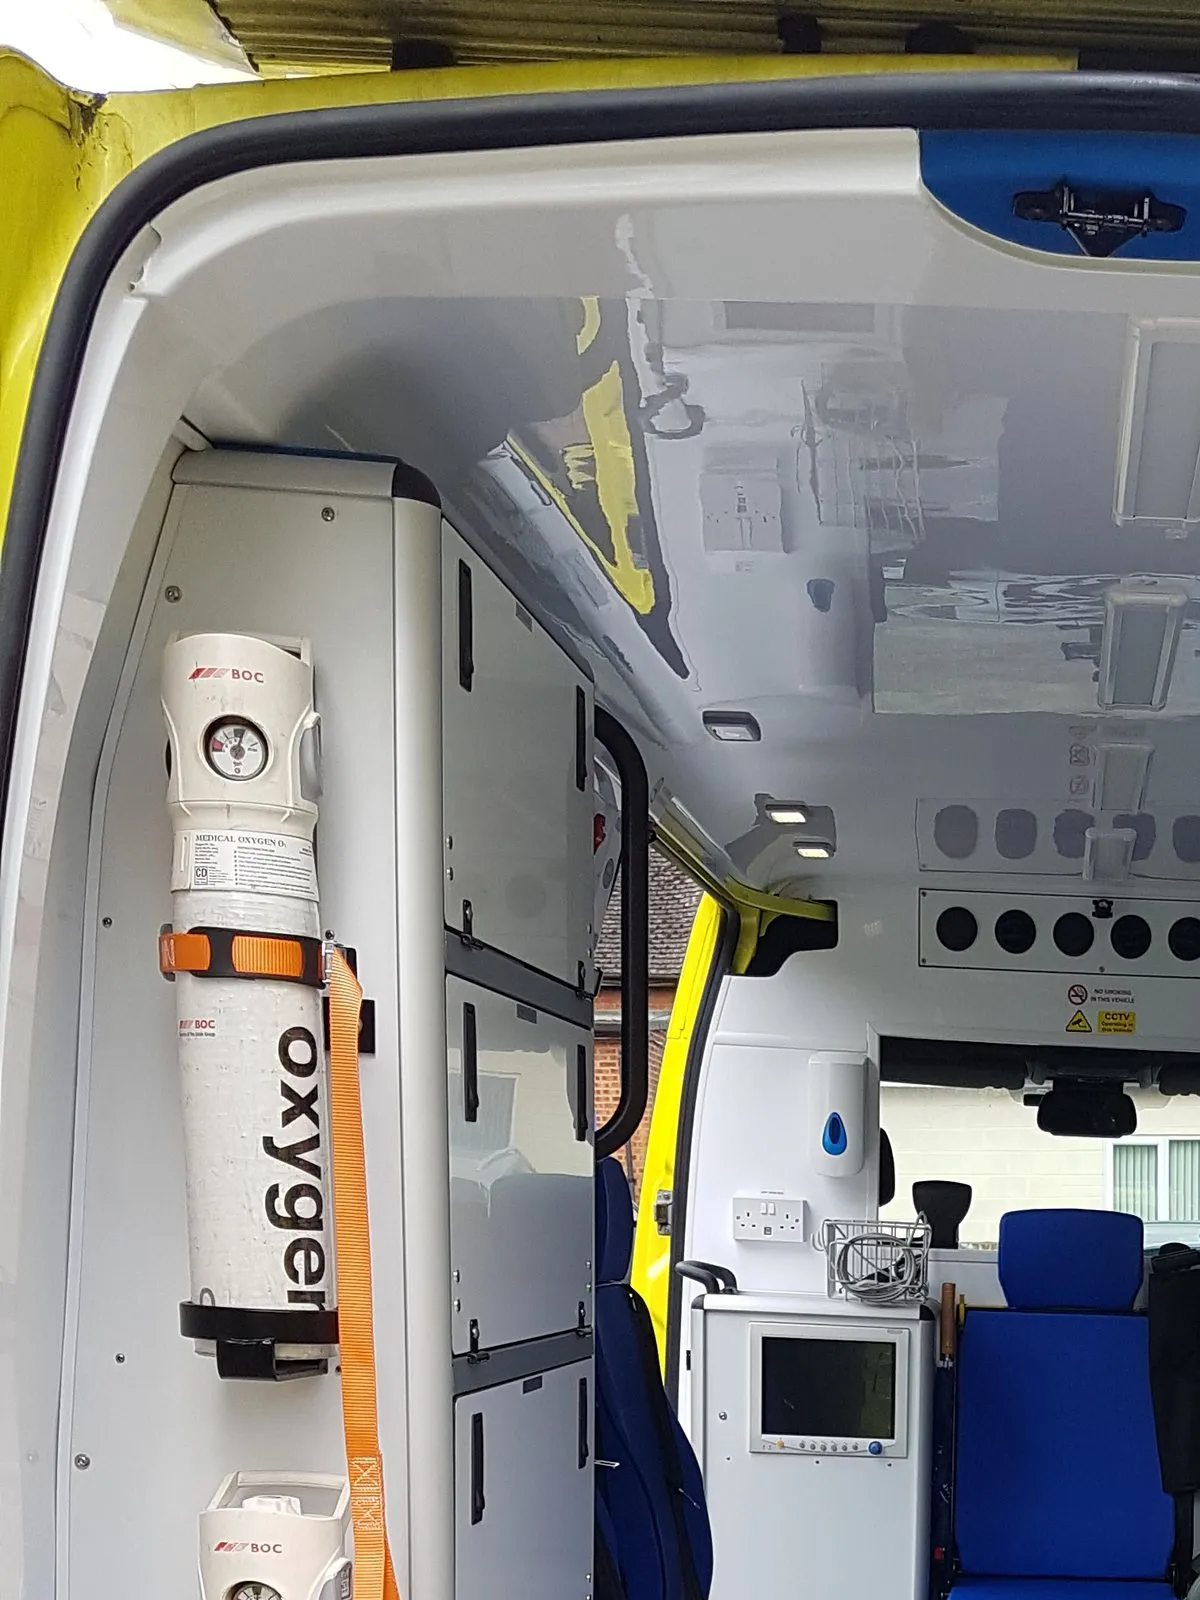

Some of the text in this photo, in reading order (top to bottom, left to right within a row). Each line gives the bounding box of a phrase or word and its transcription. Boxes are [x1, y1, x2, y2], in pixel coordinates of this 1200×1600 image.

[231, 669, 264, 683] BOC
[195, 834, 236, 843] MEDICAL
[238, 836, 276, 846] OXYGEN
[195, 868, 208, 878] CD
[1104, 1012, 1130, 1021] CCTV
[195, 1020, 215, 1029] BOC
[251, 1542, 283, 1554] BOC
